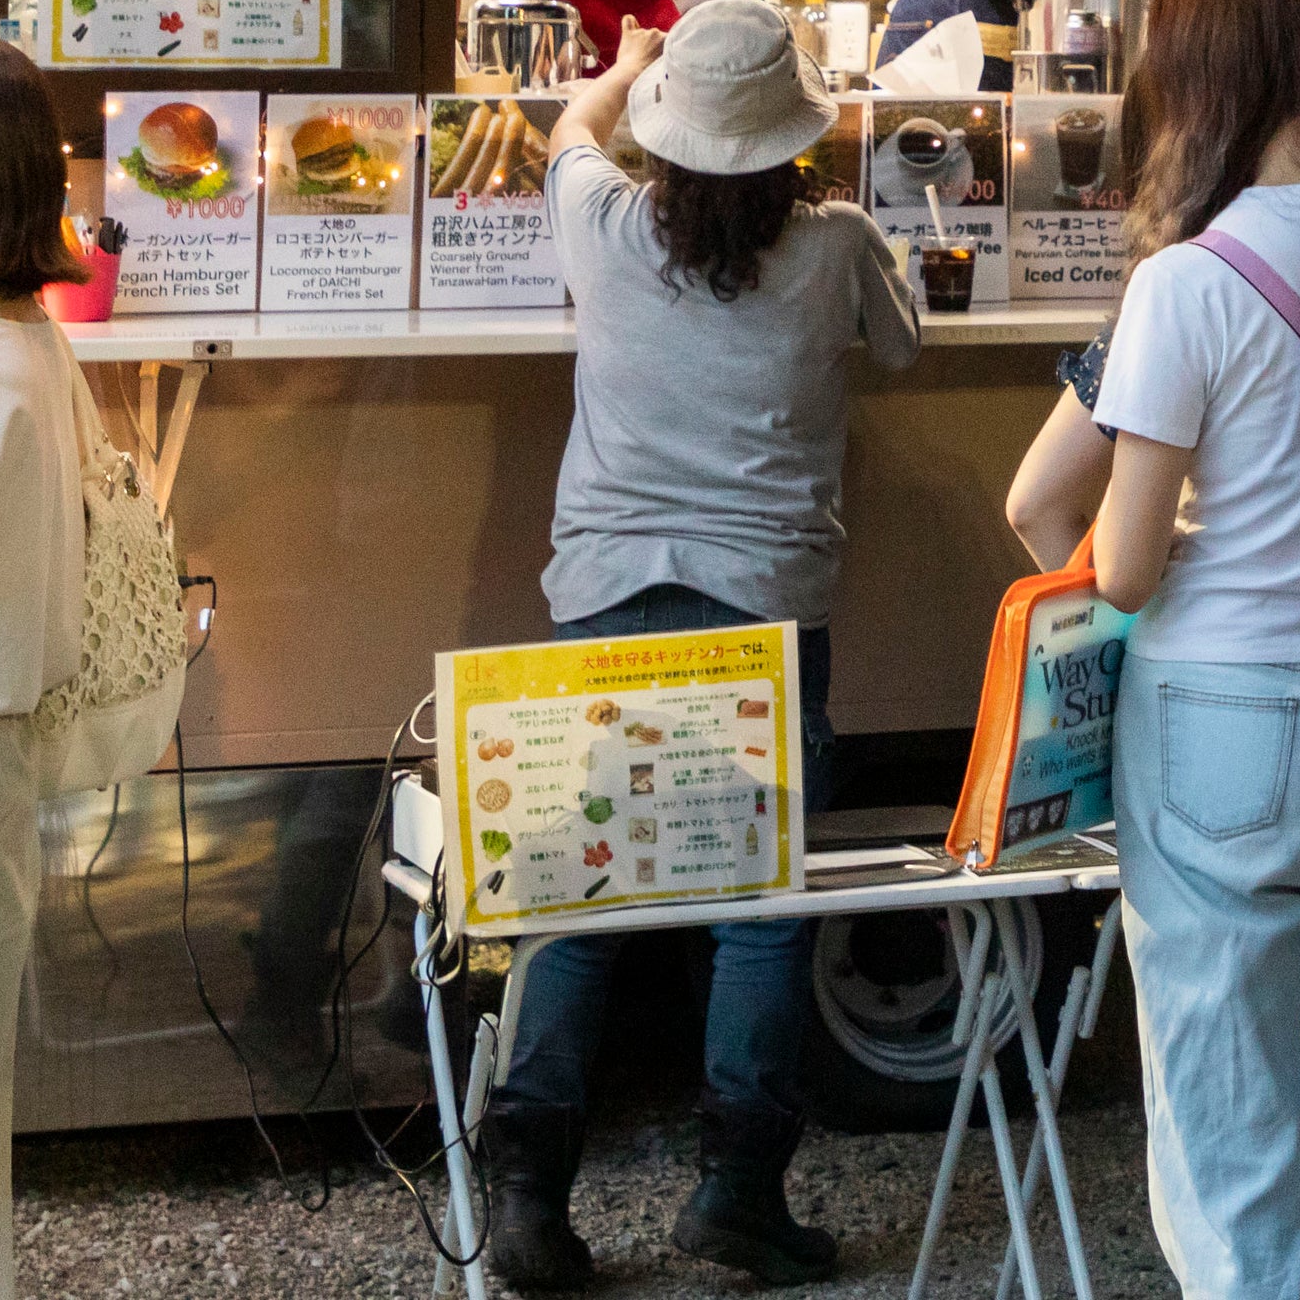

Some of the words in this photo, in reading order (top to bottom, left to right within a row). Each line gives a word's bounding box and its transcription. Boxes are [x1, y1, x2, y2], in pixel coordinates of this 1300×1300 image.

[327, 107, 403, 131] ¥1000
[166, 197, 245, 219] ¥1000
[320, 219, 356, 230] 大地の
[432, 215, 542, 231] 丹沢ハム工房の
[276, 233, 398, 244] ロコモコハンバーガー
[137, 250, 214, 262] ポテトセット
[300, 248, 373, 259] ポテトセット
[430, 251, 483, 264] Coarsely
[486, 250, 530, 262] Ground
[1065, 249, 1101, 258] Coffee
[270, 265, 331, 276] Locomoco
[335, 265, 403, 278] Hamburger
[430, 263, 472, 275] Wiener
[475, 262, 504, 274] from
[1024, 267, 1064, 282] Iced
[163, 269, 250, 282] Hamburger
[512, 275, 557, 288] Factory
[302, 277, 315, 288] of
[319, 277, 361, 288] DAICHI
[116, 285, 168, 297] French
[173, 284, 209, 296] Fries
[215, 283, 240, 295] Set
[287, 289, 328, 300] French
[332, 288, 361, 299] Fries
[365, 288, 384, 299] Set
[581, 642, 769, 670] 大地を守るキッチンカーでは、
